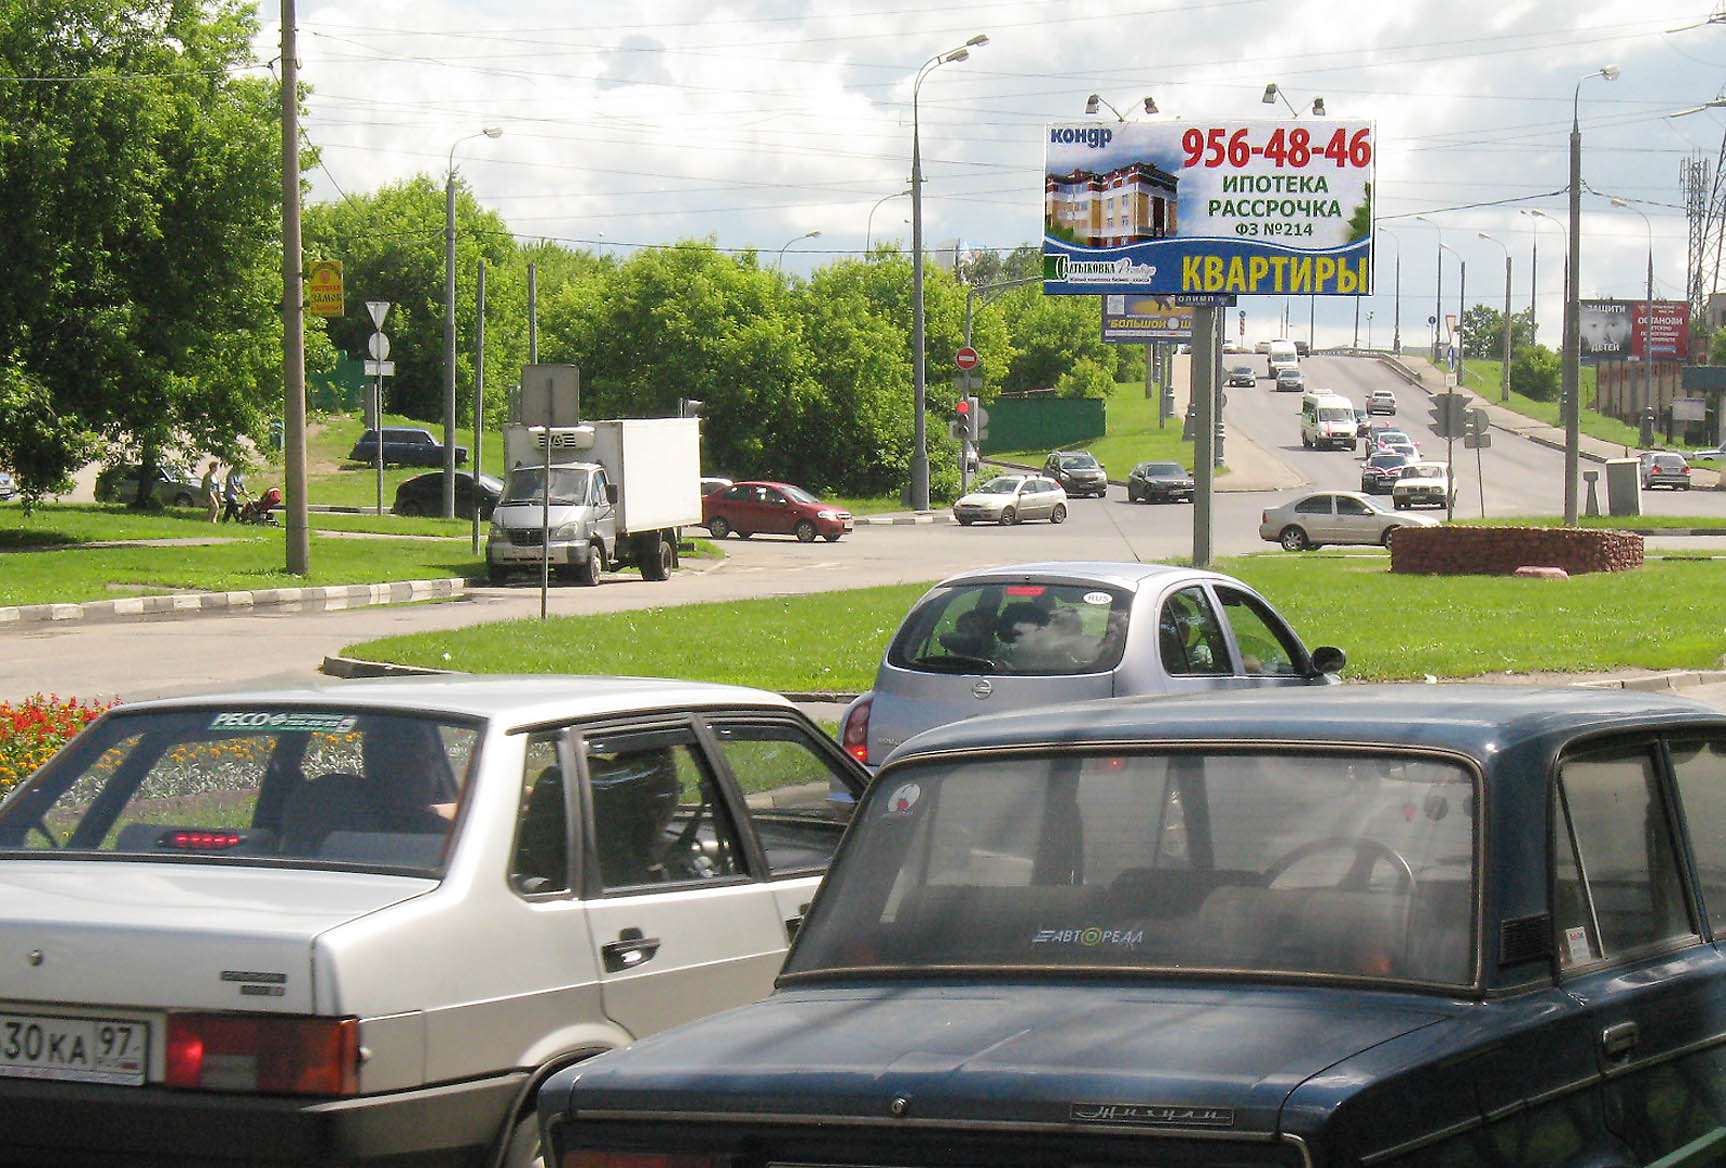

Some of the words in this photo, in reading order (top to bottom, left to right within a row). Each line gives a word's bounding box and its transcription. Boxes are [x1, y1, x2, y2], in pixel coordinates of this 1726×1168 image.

[1181, 127, 1372, 168] 956-48-46
[1222, 175, 1329, 193] ИПОТЕКА
[1207, 199, 1343, 217] РАССРОЧКА
[1235, 223, 1259, 237] ФЗ
[1263, 222, 1314, 237] №214
[1181, 256, 1368, 293] КВАРТИРЫ
[1178, 295, 1214, 303] ОЛИМП
[1587, 304, 1626, 314] ЗАЩИТИ
[1088, 594, 1109, 602] RUS
[0, 1021, 87, 1064] 30КА
[101, 1026, 132, 1056] 97
